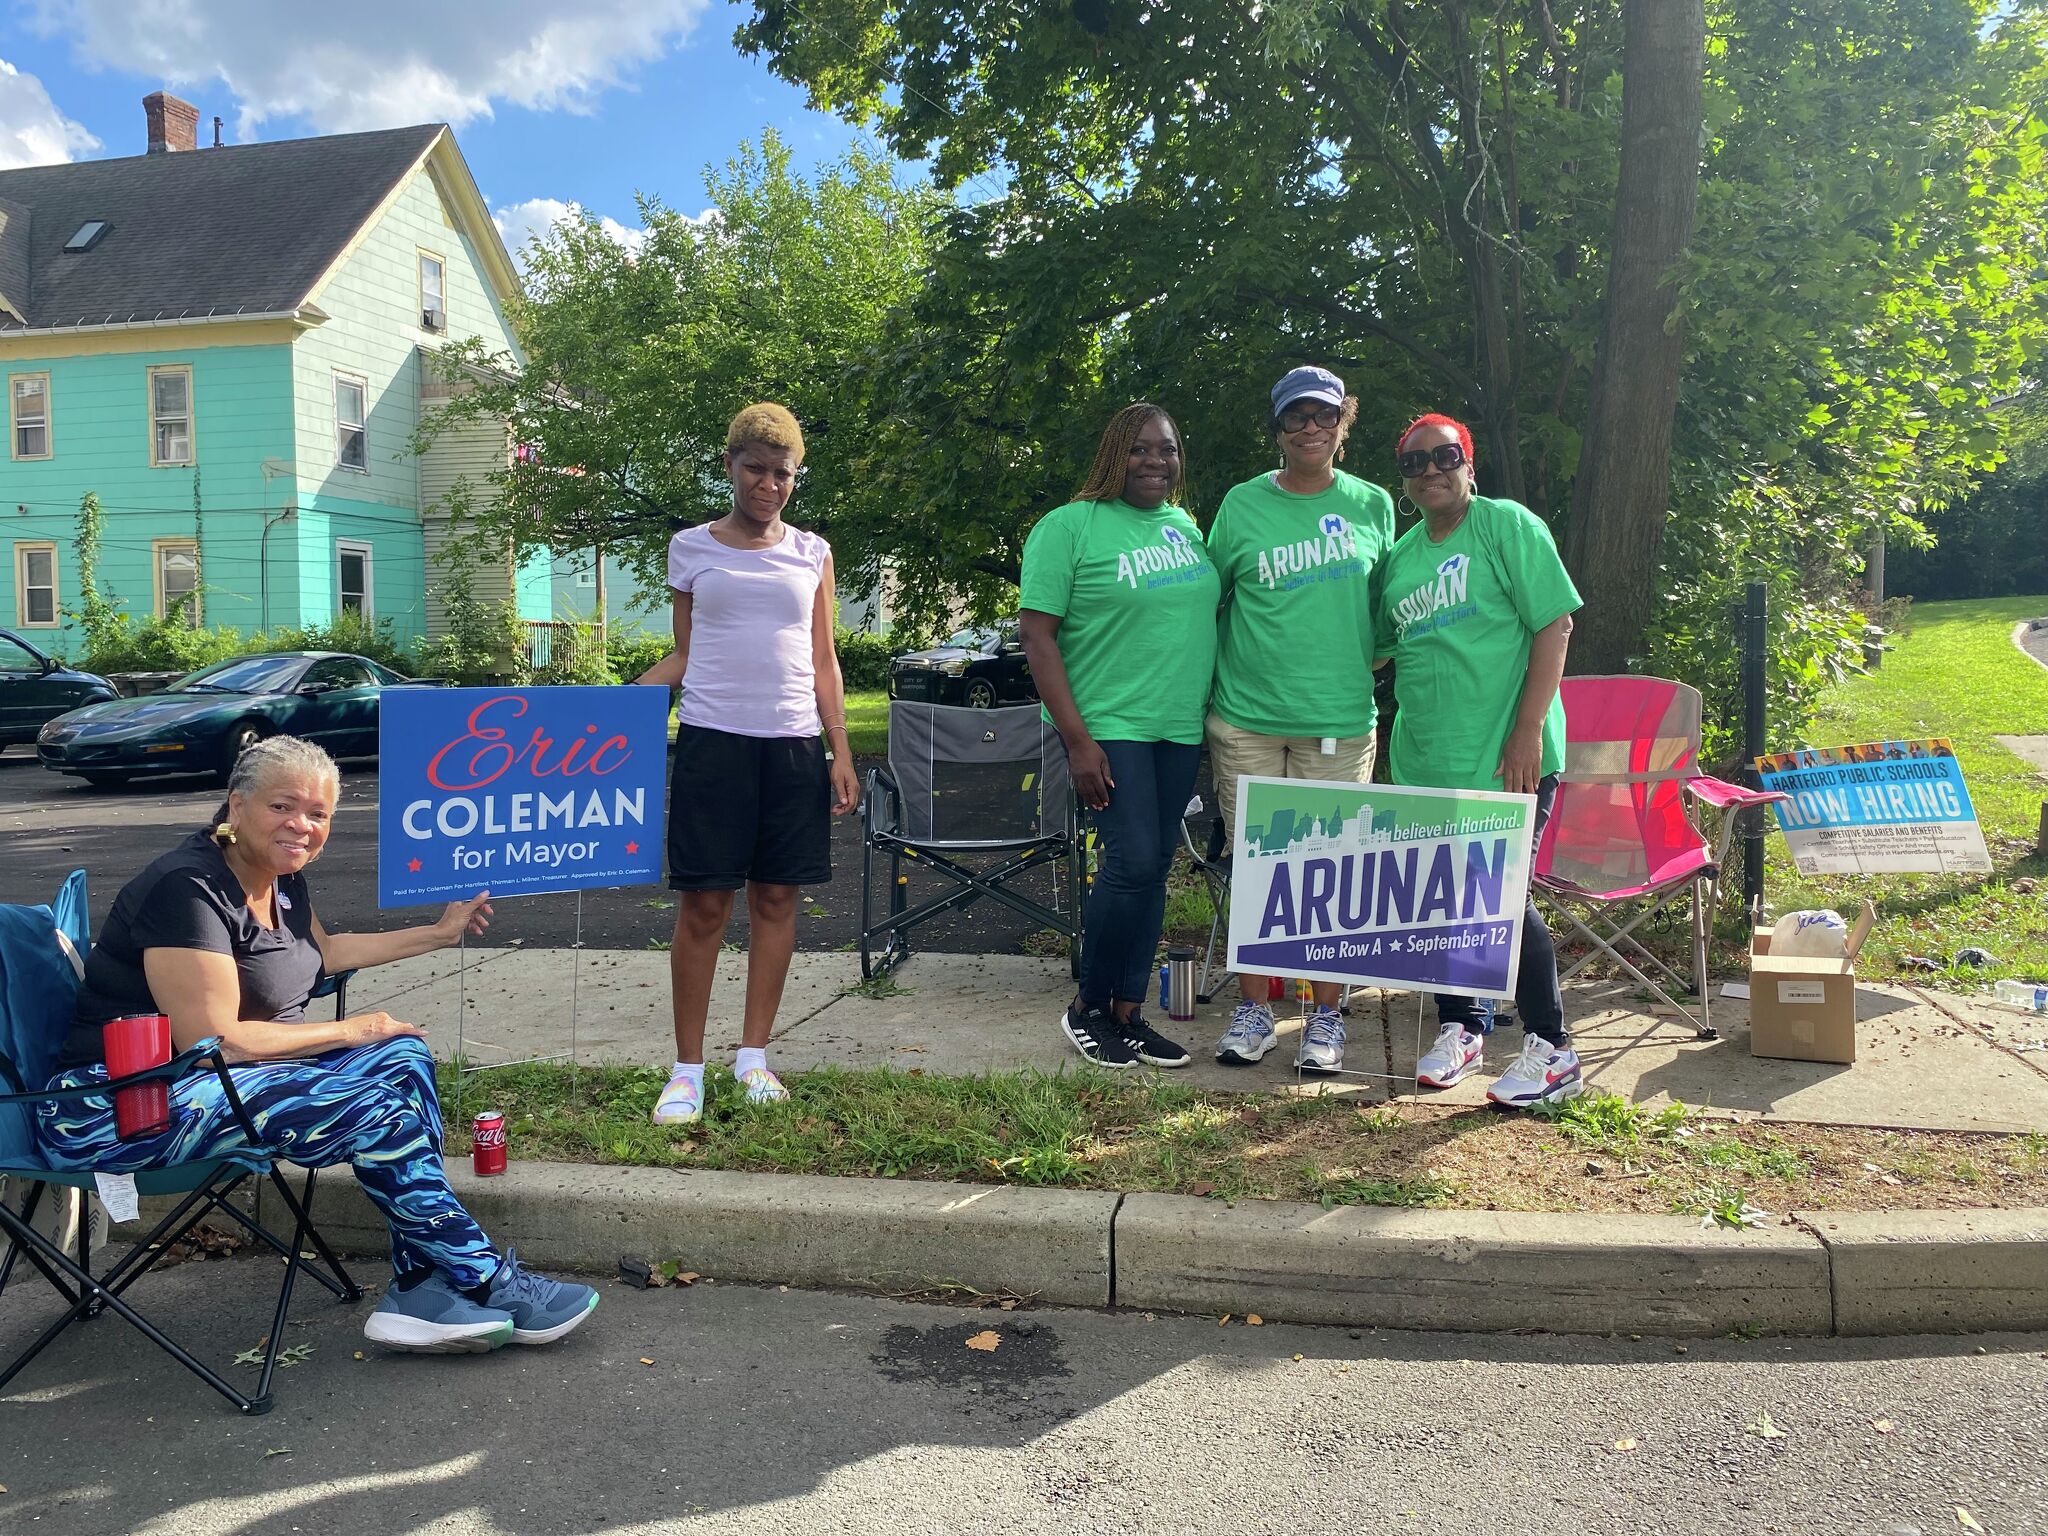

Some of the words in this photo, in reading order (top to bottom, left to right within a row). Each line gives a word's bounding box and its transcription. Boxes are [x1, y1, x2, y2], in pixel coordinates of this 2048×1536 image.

[1117, 536, 1200, 589] ARUNAN
[1258, 522, 1357, 590] ARUNAN
[426, 695, 633, 791] Eric
[1770, 770, 1837, 792] HARTFORD
[1839, 766, 1885, 785] PUBLIC
[1889, 761, 1949, 781] SCHOOLS
[402, 787, 646, 840] COLEMAN
[1779, 787, 1851, 827] NOW
[1855, 780, 1962, 821] HIRING
[1393, 821, 1441, 843] believe
[1444, 819, 1457, 838] in
[1459, 810, 1521, 835] Hartford.
[1818, 828, 1861, 840] COMPETITIVE
[1861, 827, 1895, 838] SALARIES
[1895, 826, 1911, 836] AND
[1911, 825, 1943, 836] BENEFITS
[452, 845, 496, 871] for
[505, 840, 600, 868] Mayor
[417, 887, 426, 895] by
[426, 884, 453, 893] Coleman
[570, 870, 599, 879] Approved
[599, 869, 606, 878] by
[1258, 838, 1507, 939] ARUNAN
[1304, 943, 1335, 962] Vote
[1339, 940, 1369, 958] Row
[1371, 937, 1383, 956] A
[1406, 931, 1487, 958] September
[1489, 926, 1508, 947] 12
